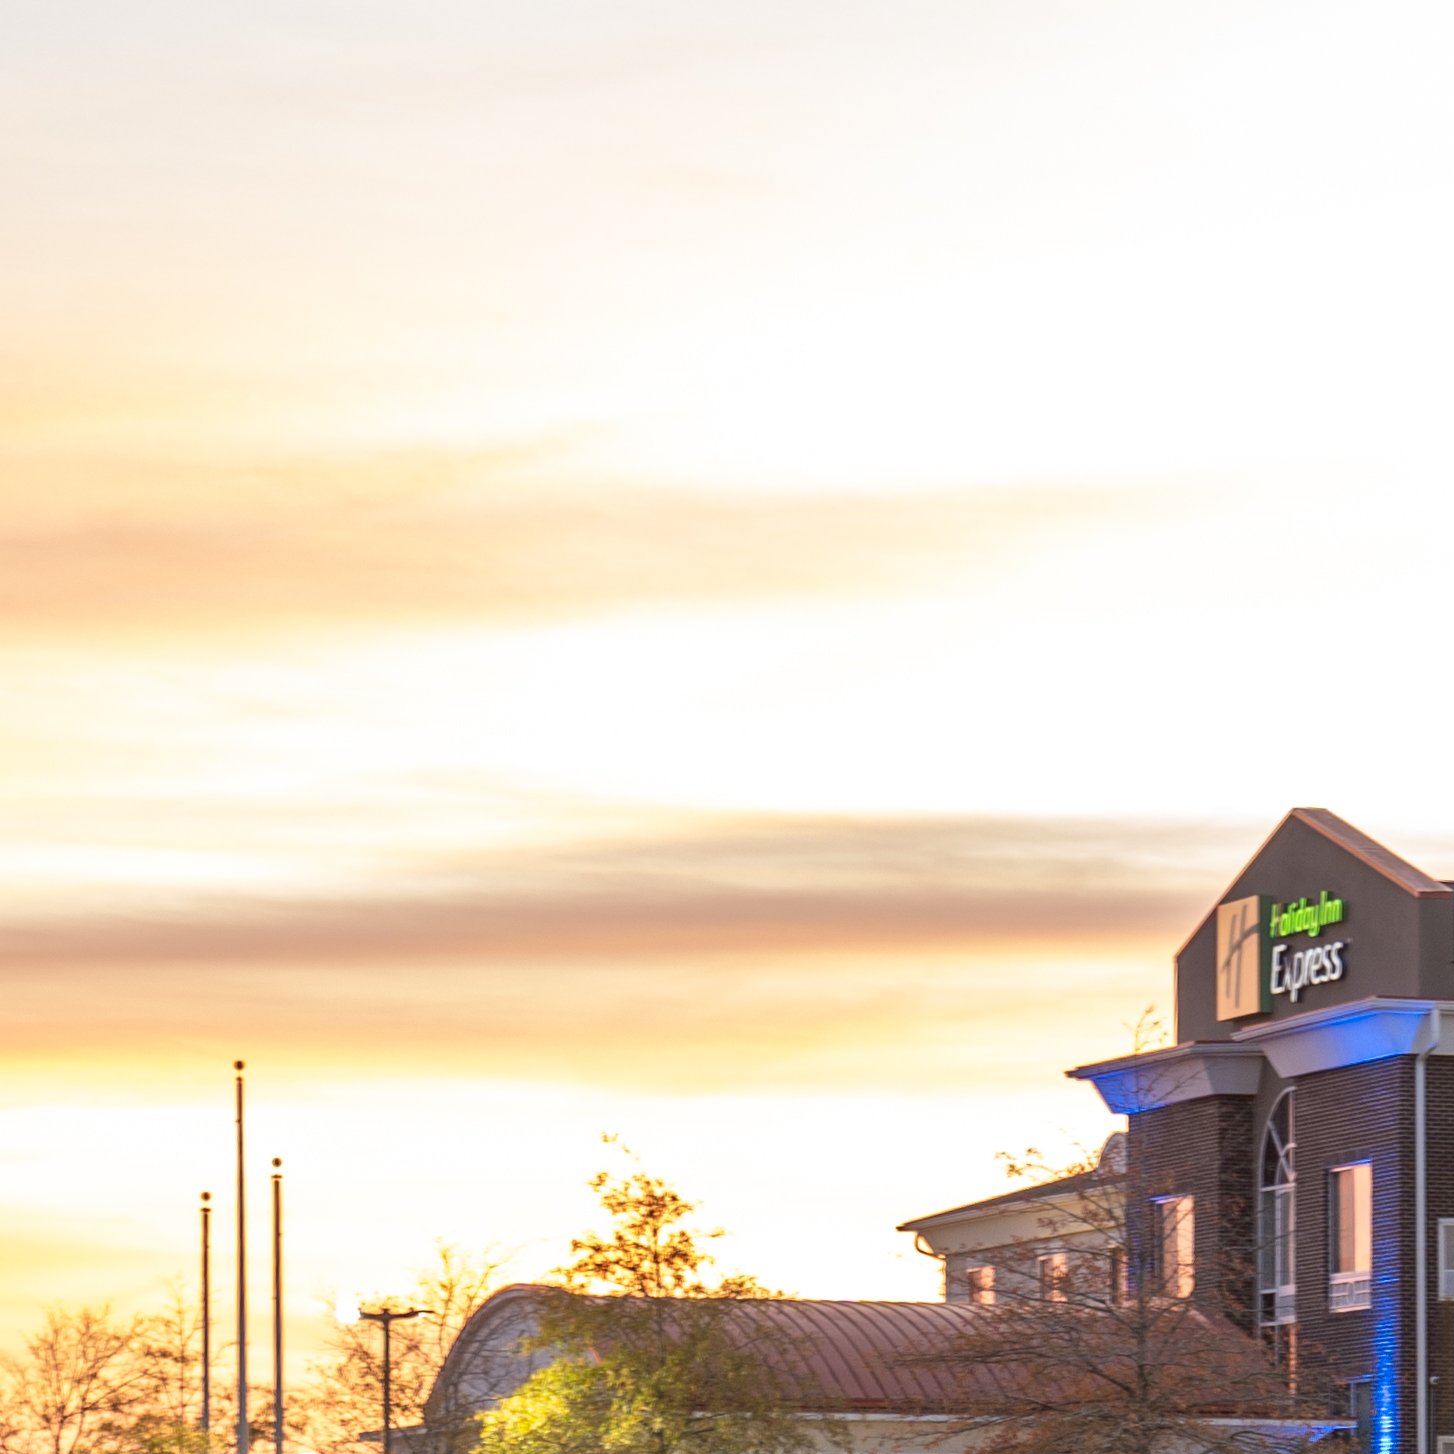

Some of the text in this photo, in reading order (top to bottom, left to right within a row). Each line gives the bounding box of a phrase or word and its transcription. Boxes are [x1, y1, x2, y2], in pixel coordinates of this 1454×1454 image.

[1269, 890, 1343, 938] Holiday Inn
[1270, 942, 1344, 1003] Express
